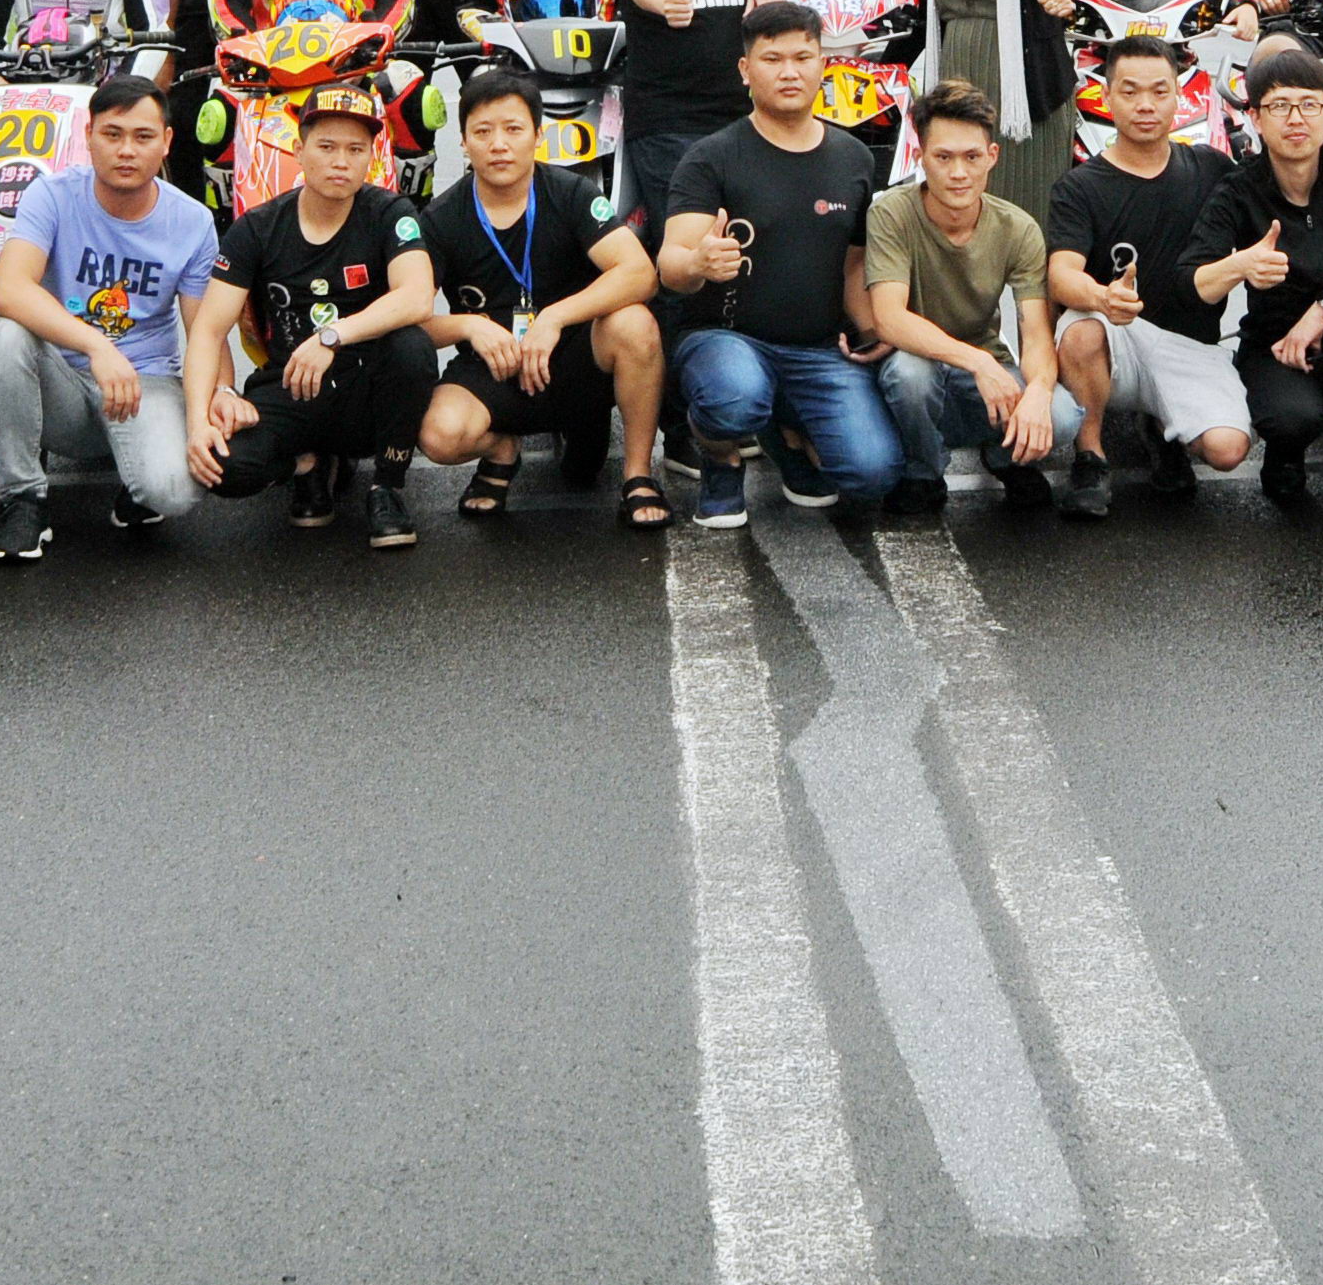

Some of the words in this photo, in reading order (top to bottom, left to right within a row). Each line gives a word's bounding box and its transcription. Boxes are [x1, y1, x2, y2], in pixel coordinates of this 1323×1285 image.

[266, 24, 331, 63] 26
[552, 28, 592, 59] 10
[821, 71, 870, 108] 17
[76, 246, 164, 298] RACE
